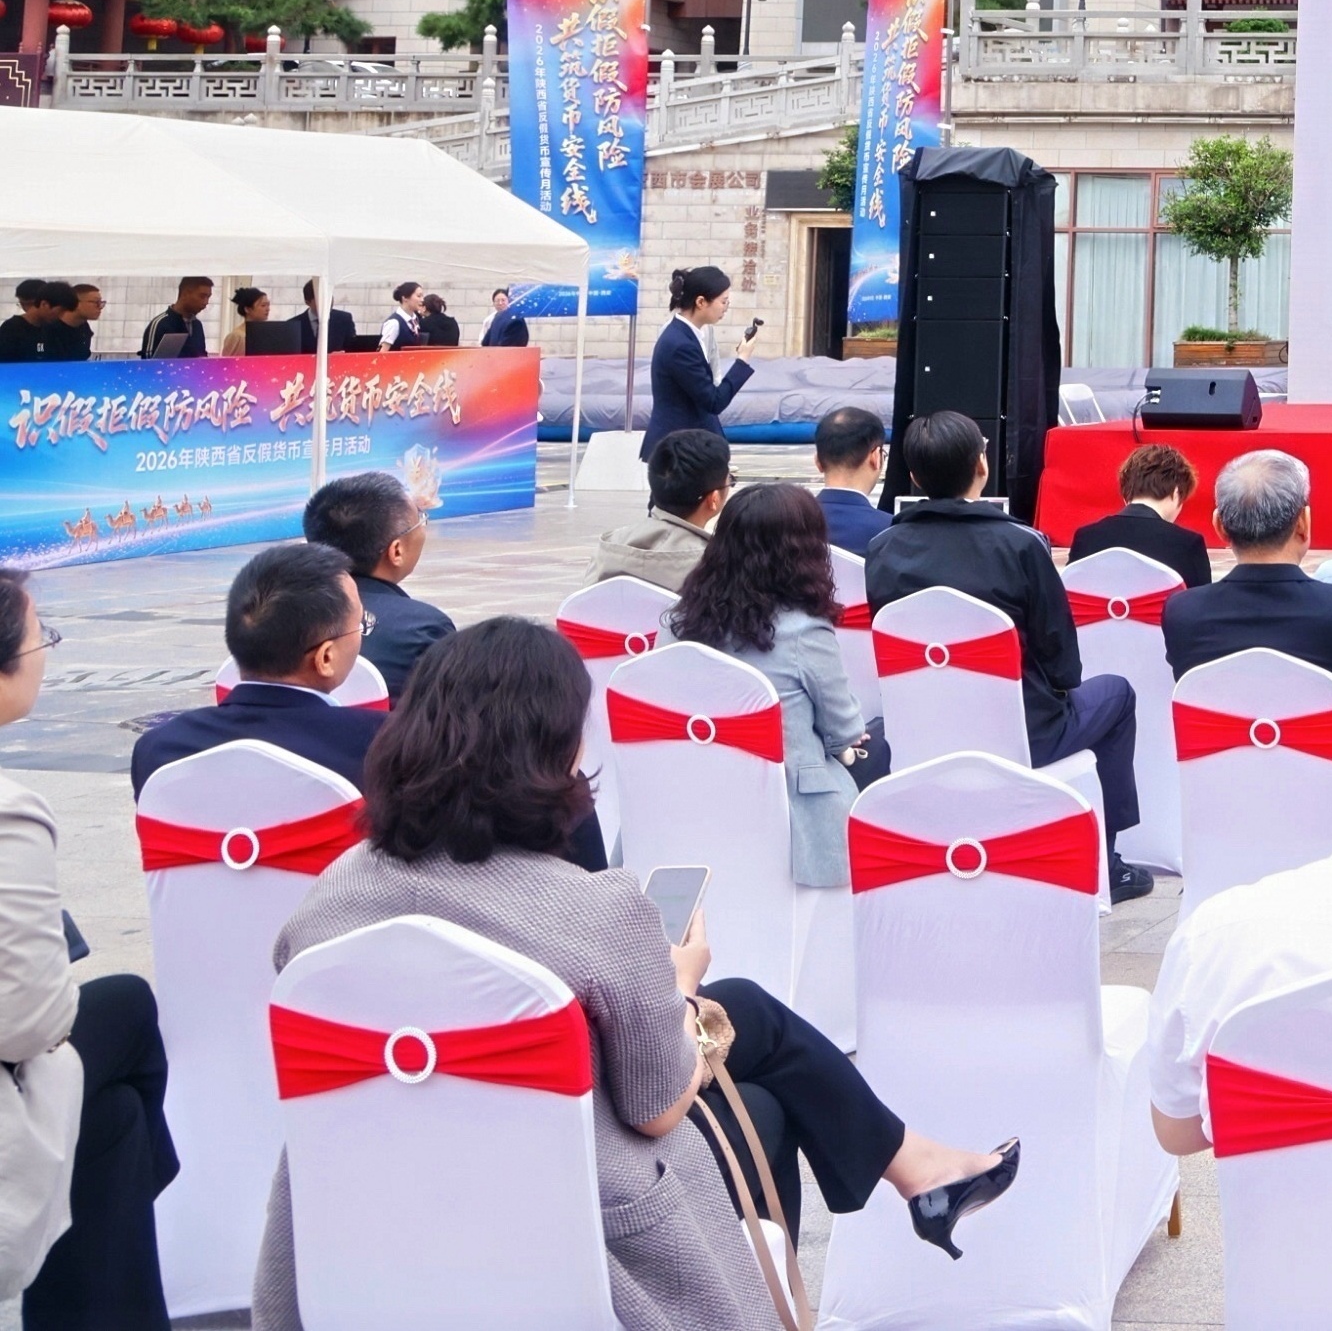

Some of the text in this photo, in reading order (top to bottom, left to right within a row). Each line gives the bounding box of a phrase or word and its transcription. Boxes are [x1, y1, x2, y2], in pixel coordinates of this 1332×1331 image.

[535, 24, 552, 213] 2026年陕西省反假货币宣传月活动
[550, 12, 598, 224] 共筑货币安全线
[867, 17, 900, 228] 共筑货币安全线
[9, 379, 258, 452] 识假拒假防风险
